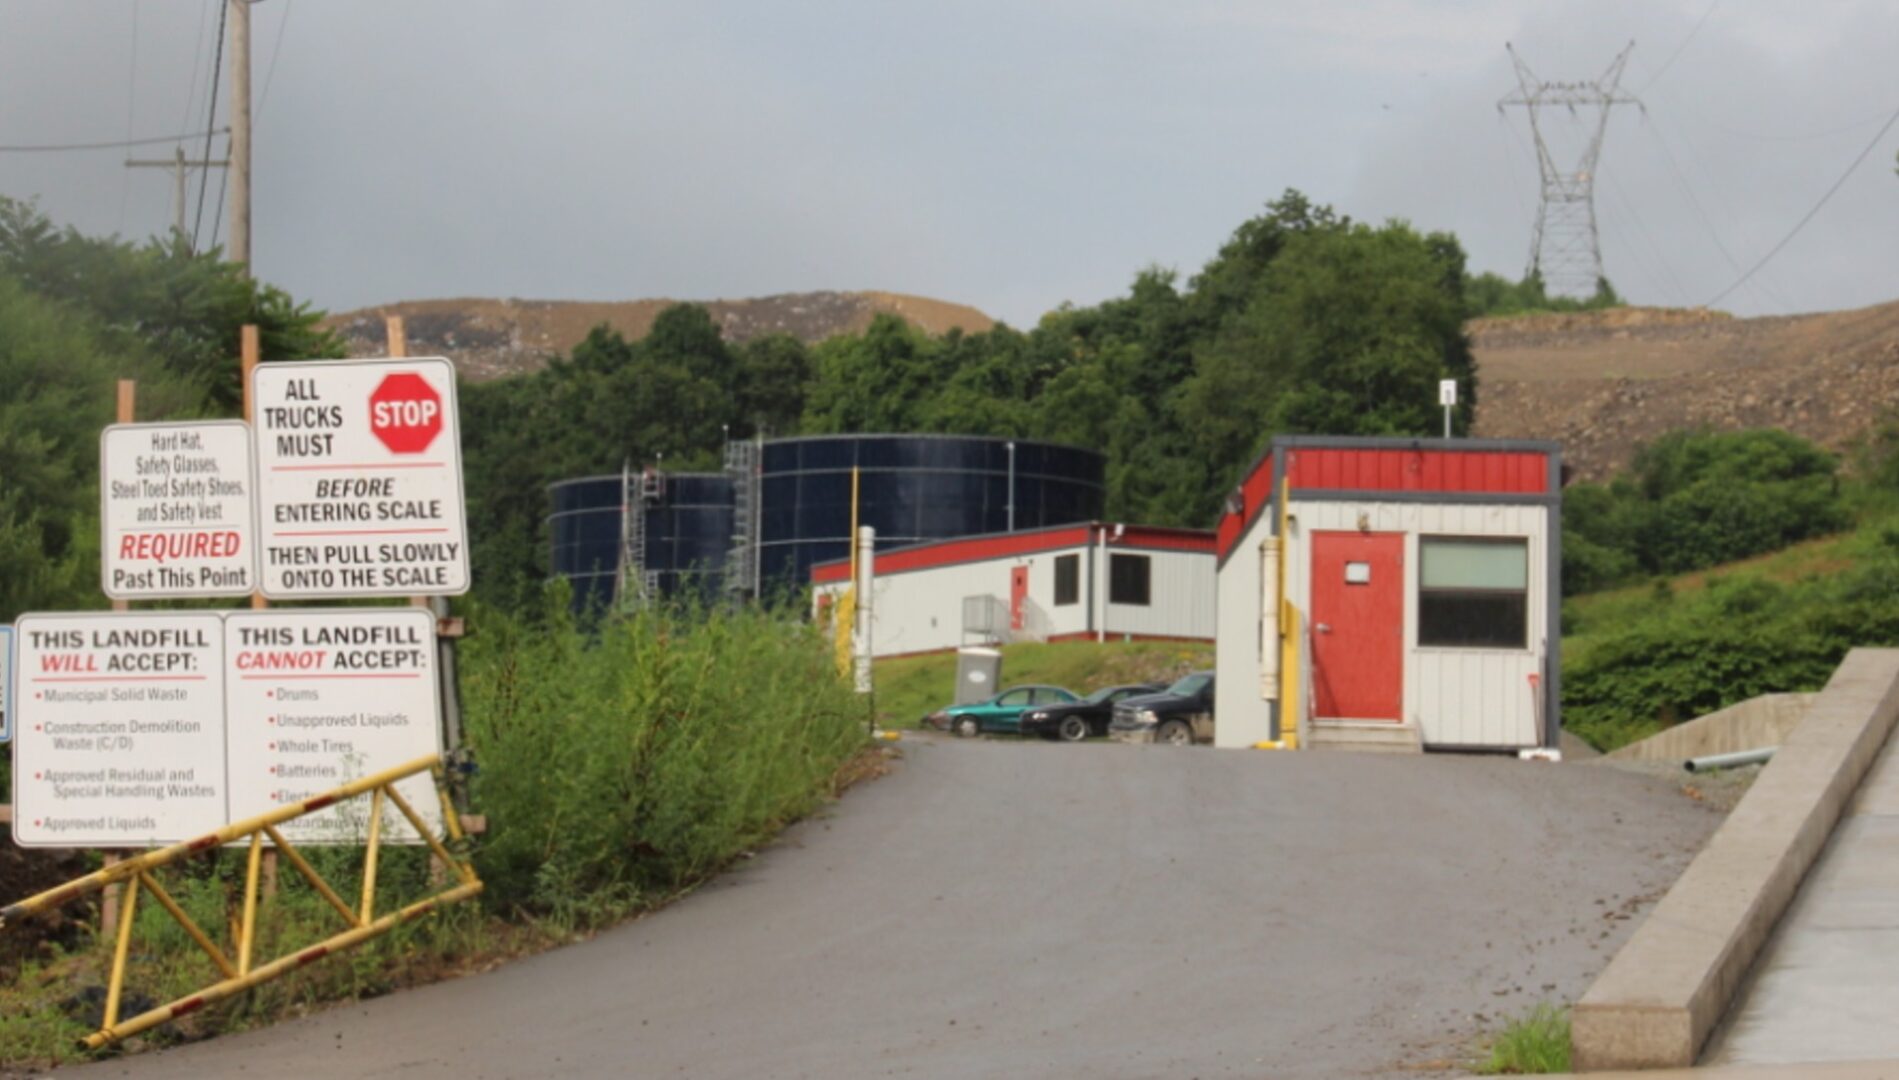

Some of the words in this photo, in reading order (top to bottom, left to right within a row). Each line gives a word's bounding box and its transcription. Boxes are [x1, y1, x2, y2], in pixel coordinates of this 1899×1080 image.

[285, 378, 320, 400] ALL
[264, 405, 343, 429] TRUCKS
[374, 400, 438, 428] STOP
[152, 432, 178, 450] Hard
[276, 434, 333, 456] MUST
[136, 455, 170, 477] Safety
[112, 480, 141, 499] Steel
[142, 479, 168, 498] Toed
[171, 477, 205, 501] Safety
[316, 477, 395, 499] BEFORE
[137, 503, 157, 522] and
[161, 503, 195, 525] Safety
[198, 502, 222, 520] Vest
[274, 502, 371, 523] ENTERING
[377, 500, 441, 521] SCALE
[119, 531, 241, 564] REQUIRED
[268, 547, 319, 565] THEN
[325, 545, 374, 564] PULL
[379, 543, 459, 563] SLOWLY
[113, 568, 154, 589] Past
[158, 567, 195, 588] This
[200, 566, 247, 587] Point
[281, 569, 334, 589] ONTO
[339, 568, 378, 588] THE
[383, 567, 448, 587] SCALE
[29, 630, 84, 649] THIS
[92, 629, 210, 648] LANDFILL
[239, 627, 294, 646] THIS
[302, 626, 421, 645] LANDFILL
[41, 653, 98, 672] WILL
[107, 652, 198, 672] ACCEPT:
[236, 651, 326, 670] CANNOT
[334, 650, 426, 669] ACCEPT:
[44, 689, 107, 705] Municipal
[111, 688, 144, 702] Solid
[148, 687, 188, 701] Waste
[276, 687, 319, 701] Drums
[44, 720, 125, 734] Construction
[129, 719, 201, 733] Demolition
[277, 713, 357, 728] Unapproved
[360, 713, 409, 728] Liquids
[53, 737, 92, 750] Waste
[278, 739, 319, 753] Whole
[322, 738, 353, 753] Tires
[44, 769, 105, 783] Approved
[108, 768, 165, 782] Residual
[169, 768, 194, 781] and
[277, 763, 336, 778] Batteries
[53, 784, 101, 800] Special
[105, 783, 165, 800] Handling
[167, 783, 216, 798] Wastes
[44, 816, 105, 831] Approved
[108, 816, 156, 831] Liquids
